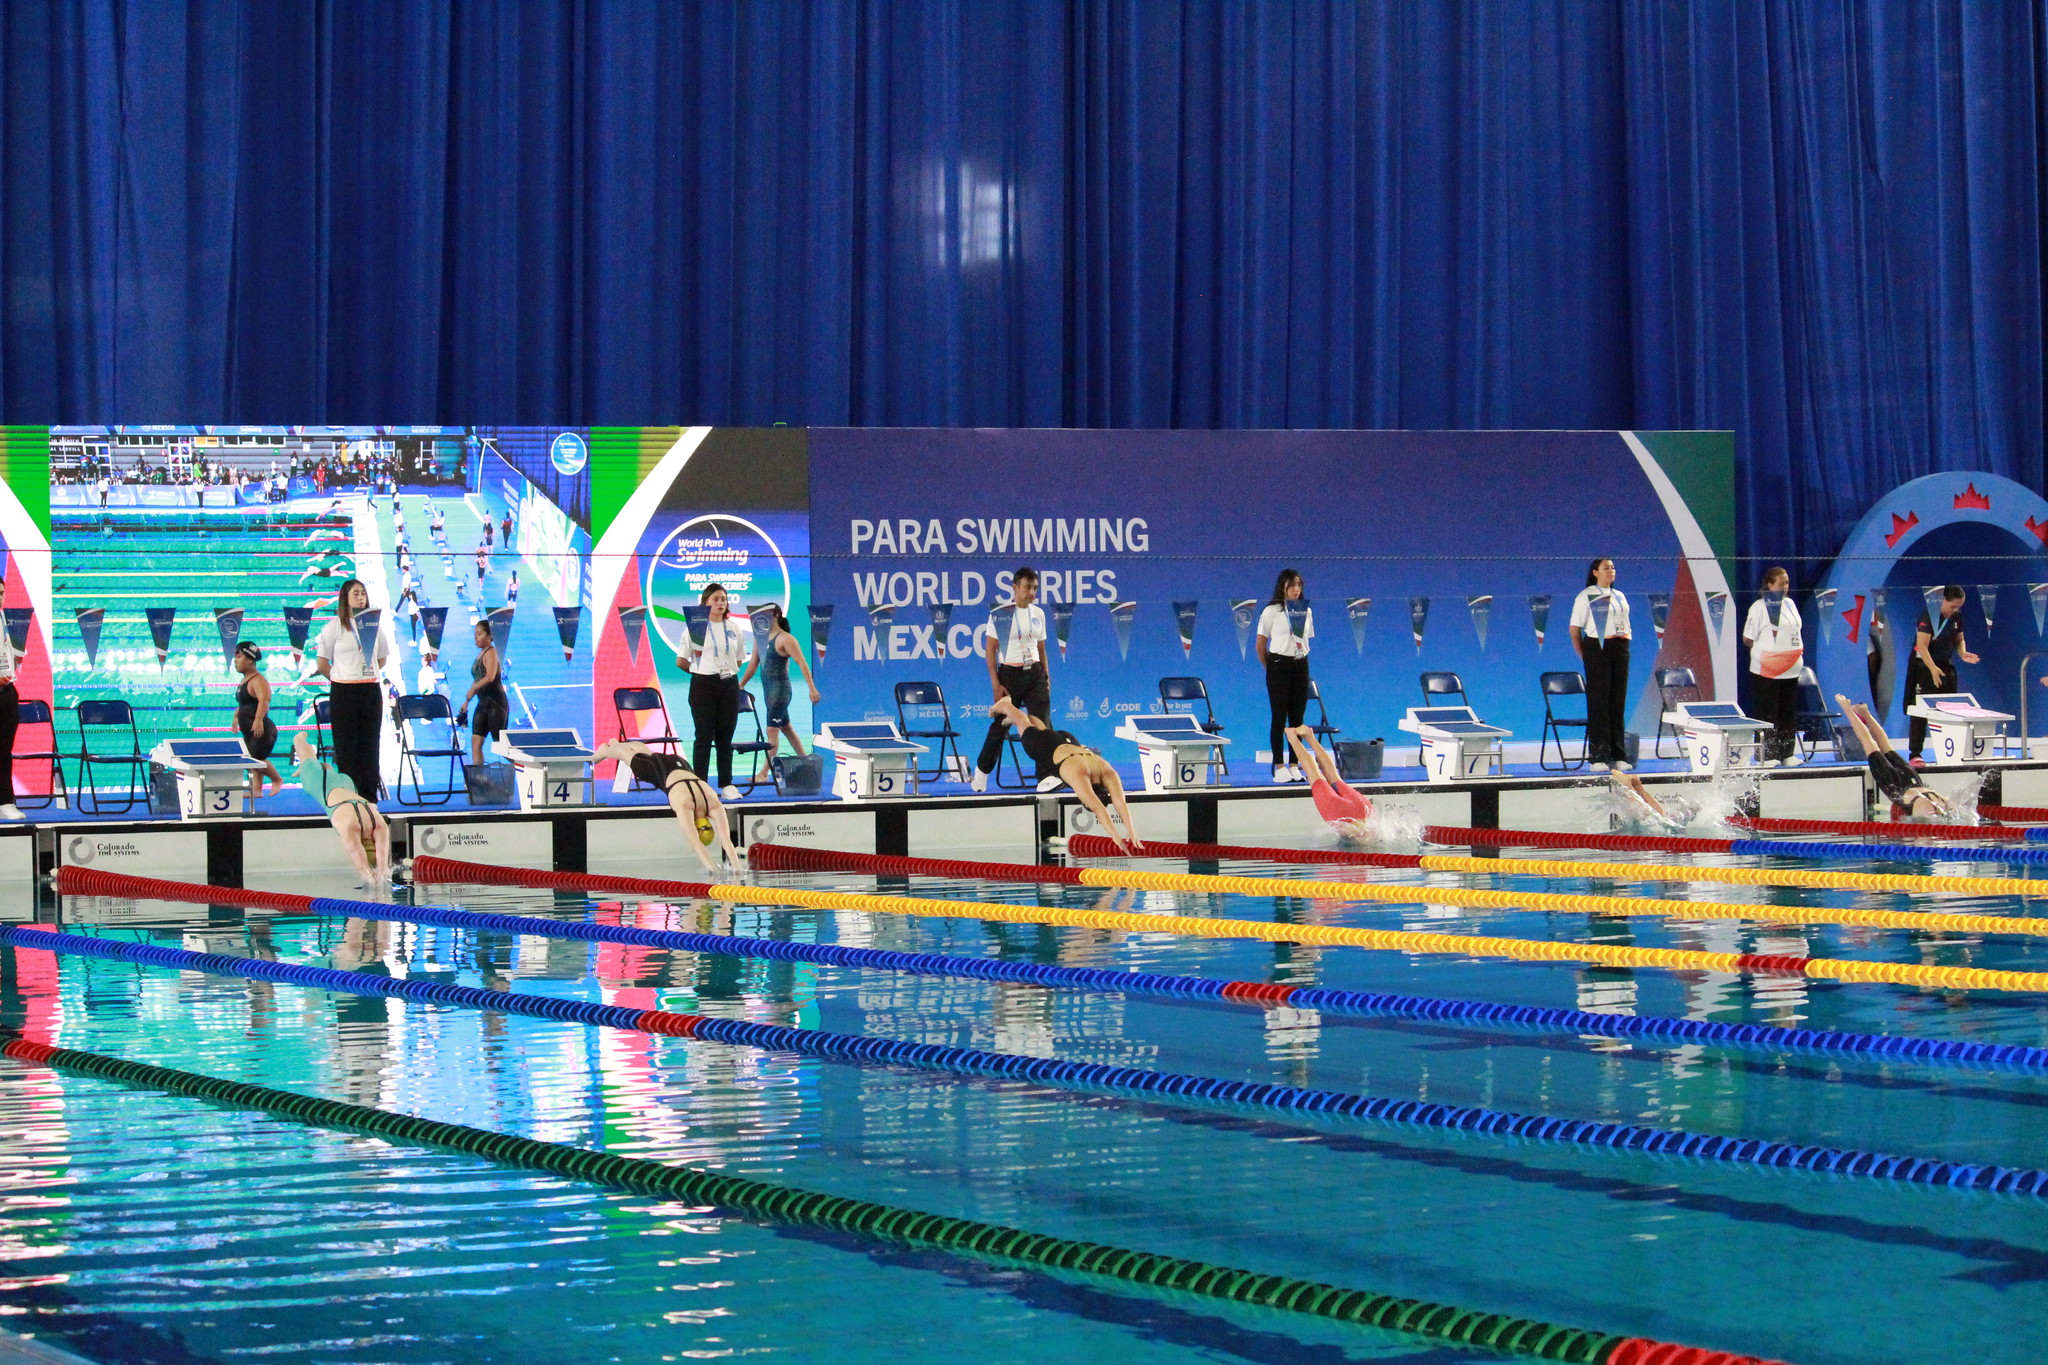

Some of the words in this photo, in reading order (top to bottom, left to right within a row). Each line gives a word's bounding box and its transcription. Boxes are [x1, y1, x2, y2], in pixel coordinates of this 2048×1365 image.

[678, 539, 702, 548] World
[704, 539, 724, 548] Para
[851, 518, 948, 554] PARA
[956, 517, 1149, 554] SWIMMING
[676, 547, 749, 566] Swimming
[684, 573, 706, 582] PARA
[708, 573, 753, 582] SWIMMING
[853, 571, 986, 608] WORLD
[994, 569, 1118, 605] SRIES
[1115, 703, 1141, 712] CODE
[1700, 745, 1710, 766] 8
[1945, 737, 1955, 757] 9
[1974, 739, 1985, 756] 9
[1153, 763, 1162, 785] 6
[1181, 764, 1195, 783] 6
[1436, 753, 1445, 775] 7
[527, 780, 534, 804] 4
[553, 781, 570, 802] 4
[849, 771, 858, 794] 5
[878, 773, 894, 792] 5
[187, 789, 193, 813] 3
[213, 789, 231, 812] 3
